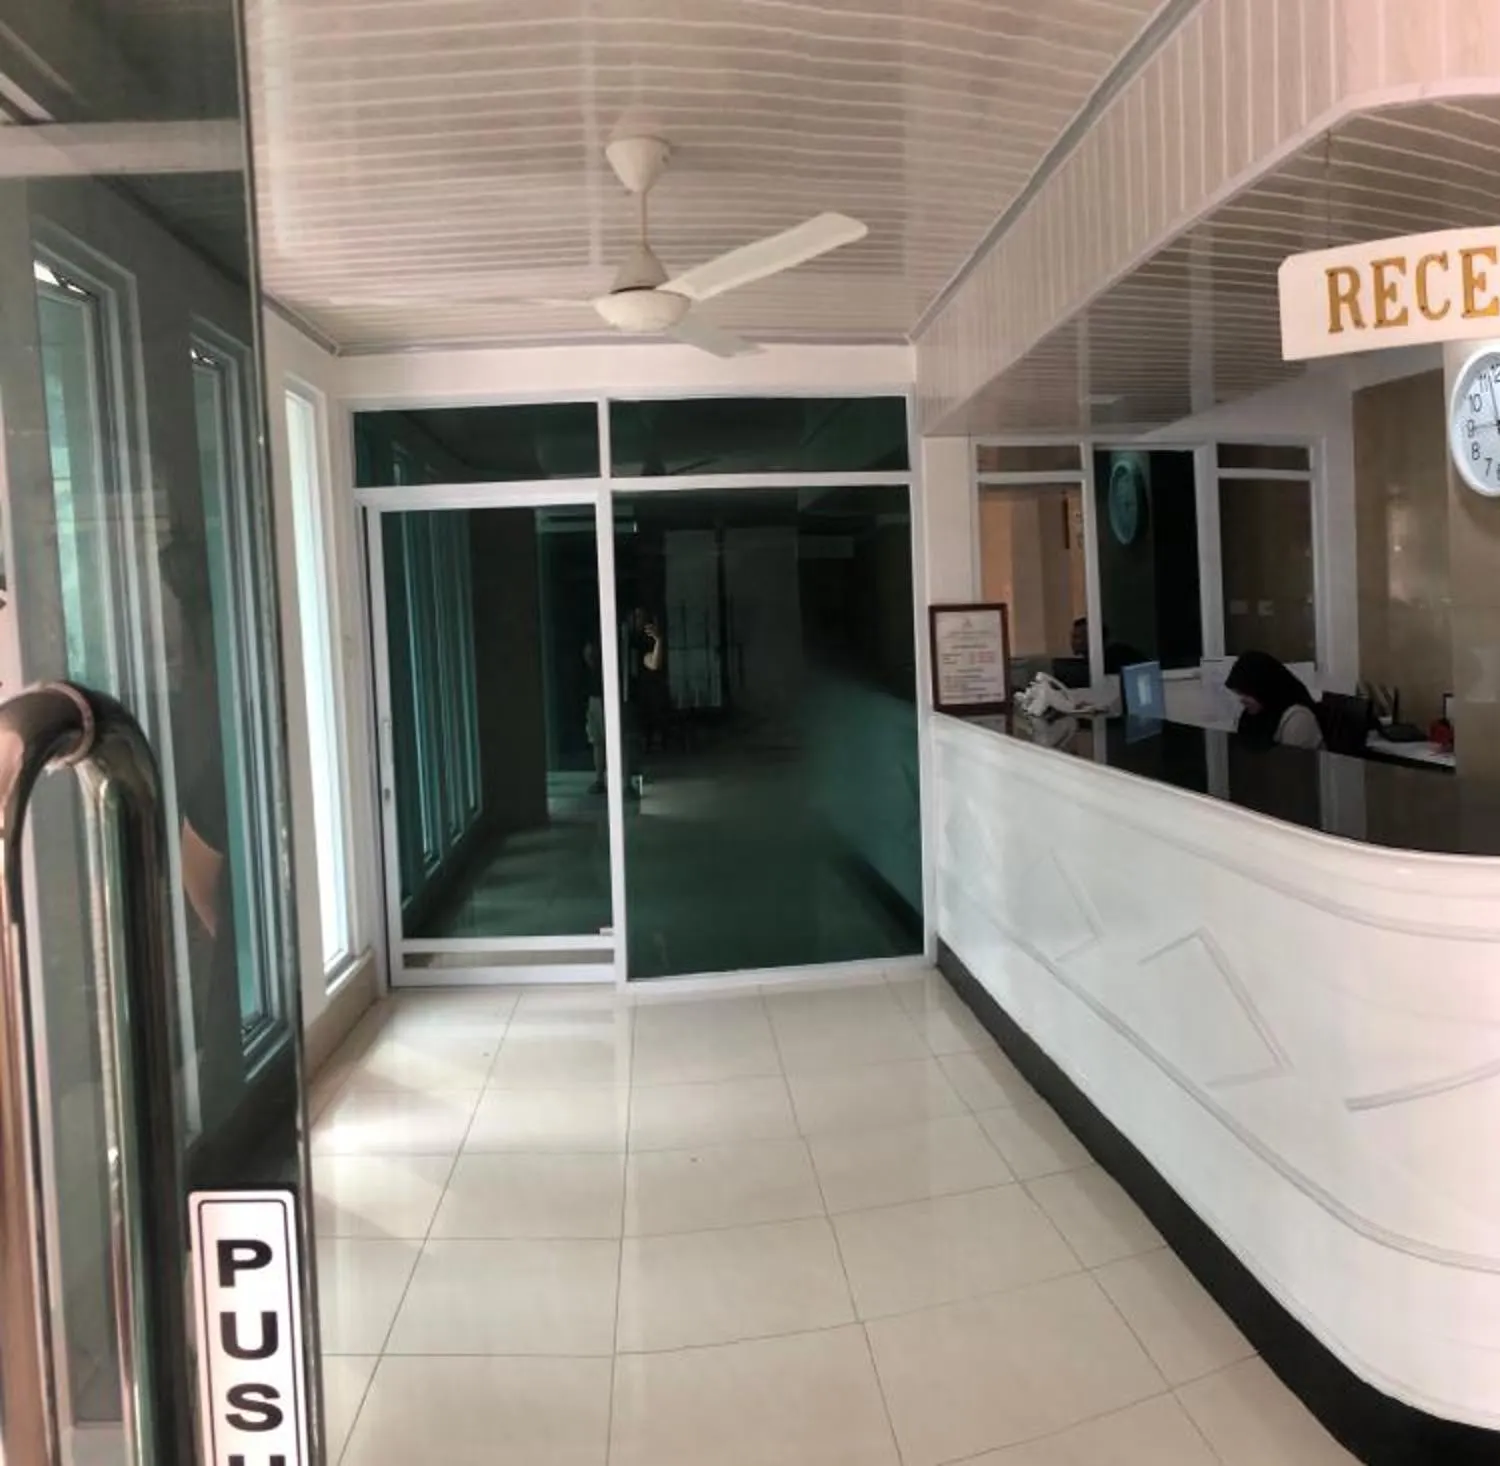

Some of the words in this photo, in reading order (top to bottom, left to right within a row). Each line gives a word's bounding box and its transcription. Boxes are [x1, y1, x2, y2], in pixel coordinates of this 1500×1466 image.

[1469, 393, 1482, 413] 10
[1466, 418, 1475, 439] 9
[1471, 441, 1481, 461] 8
[1484, 457, 1493, 477] 7
[216, 1239, 285, 1466] PUS
